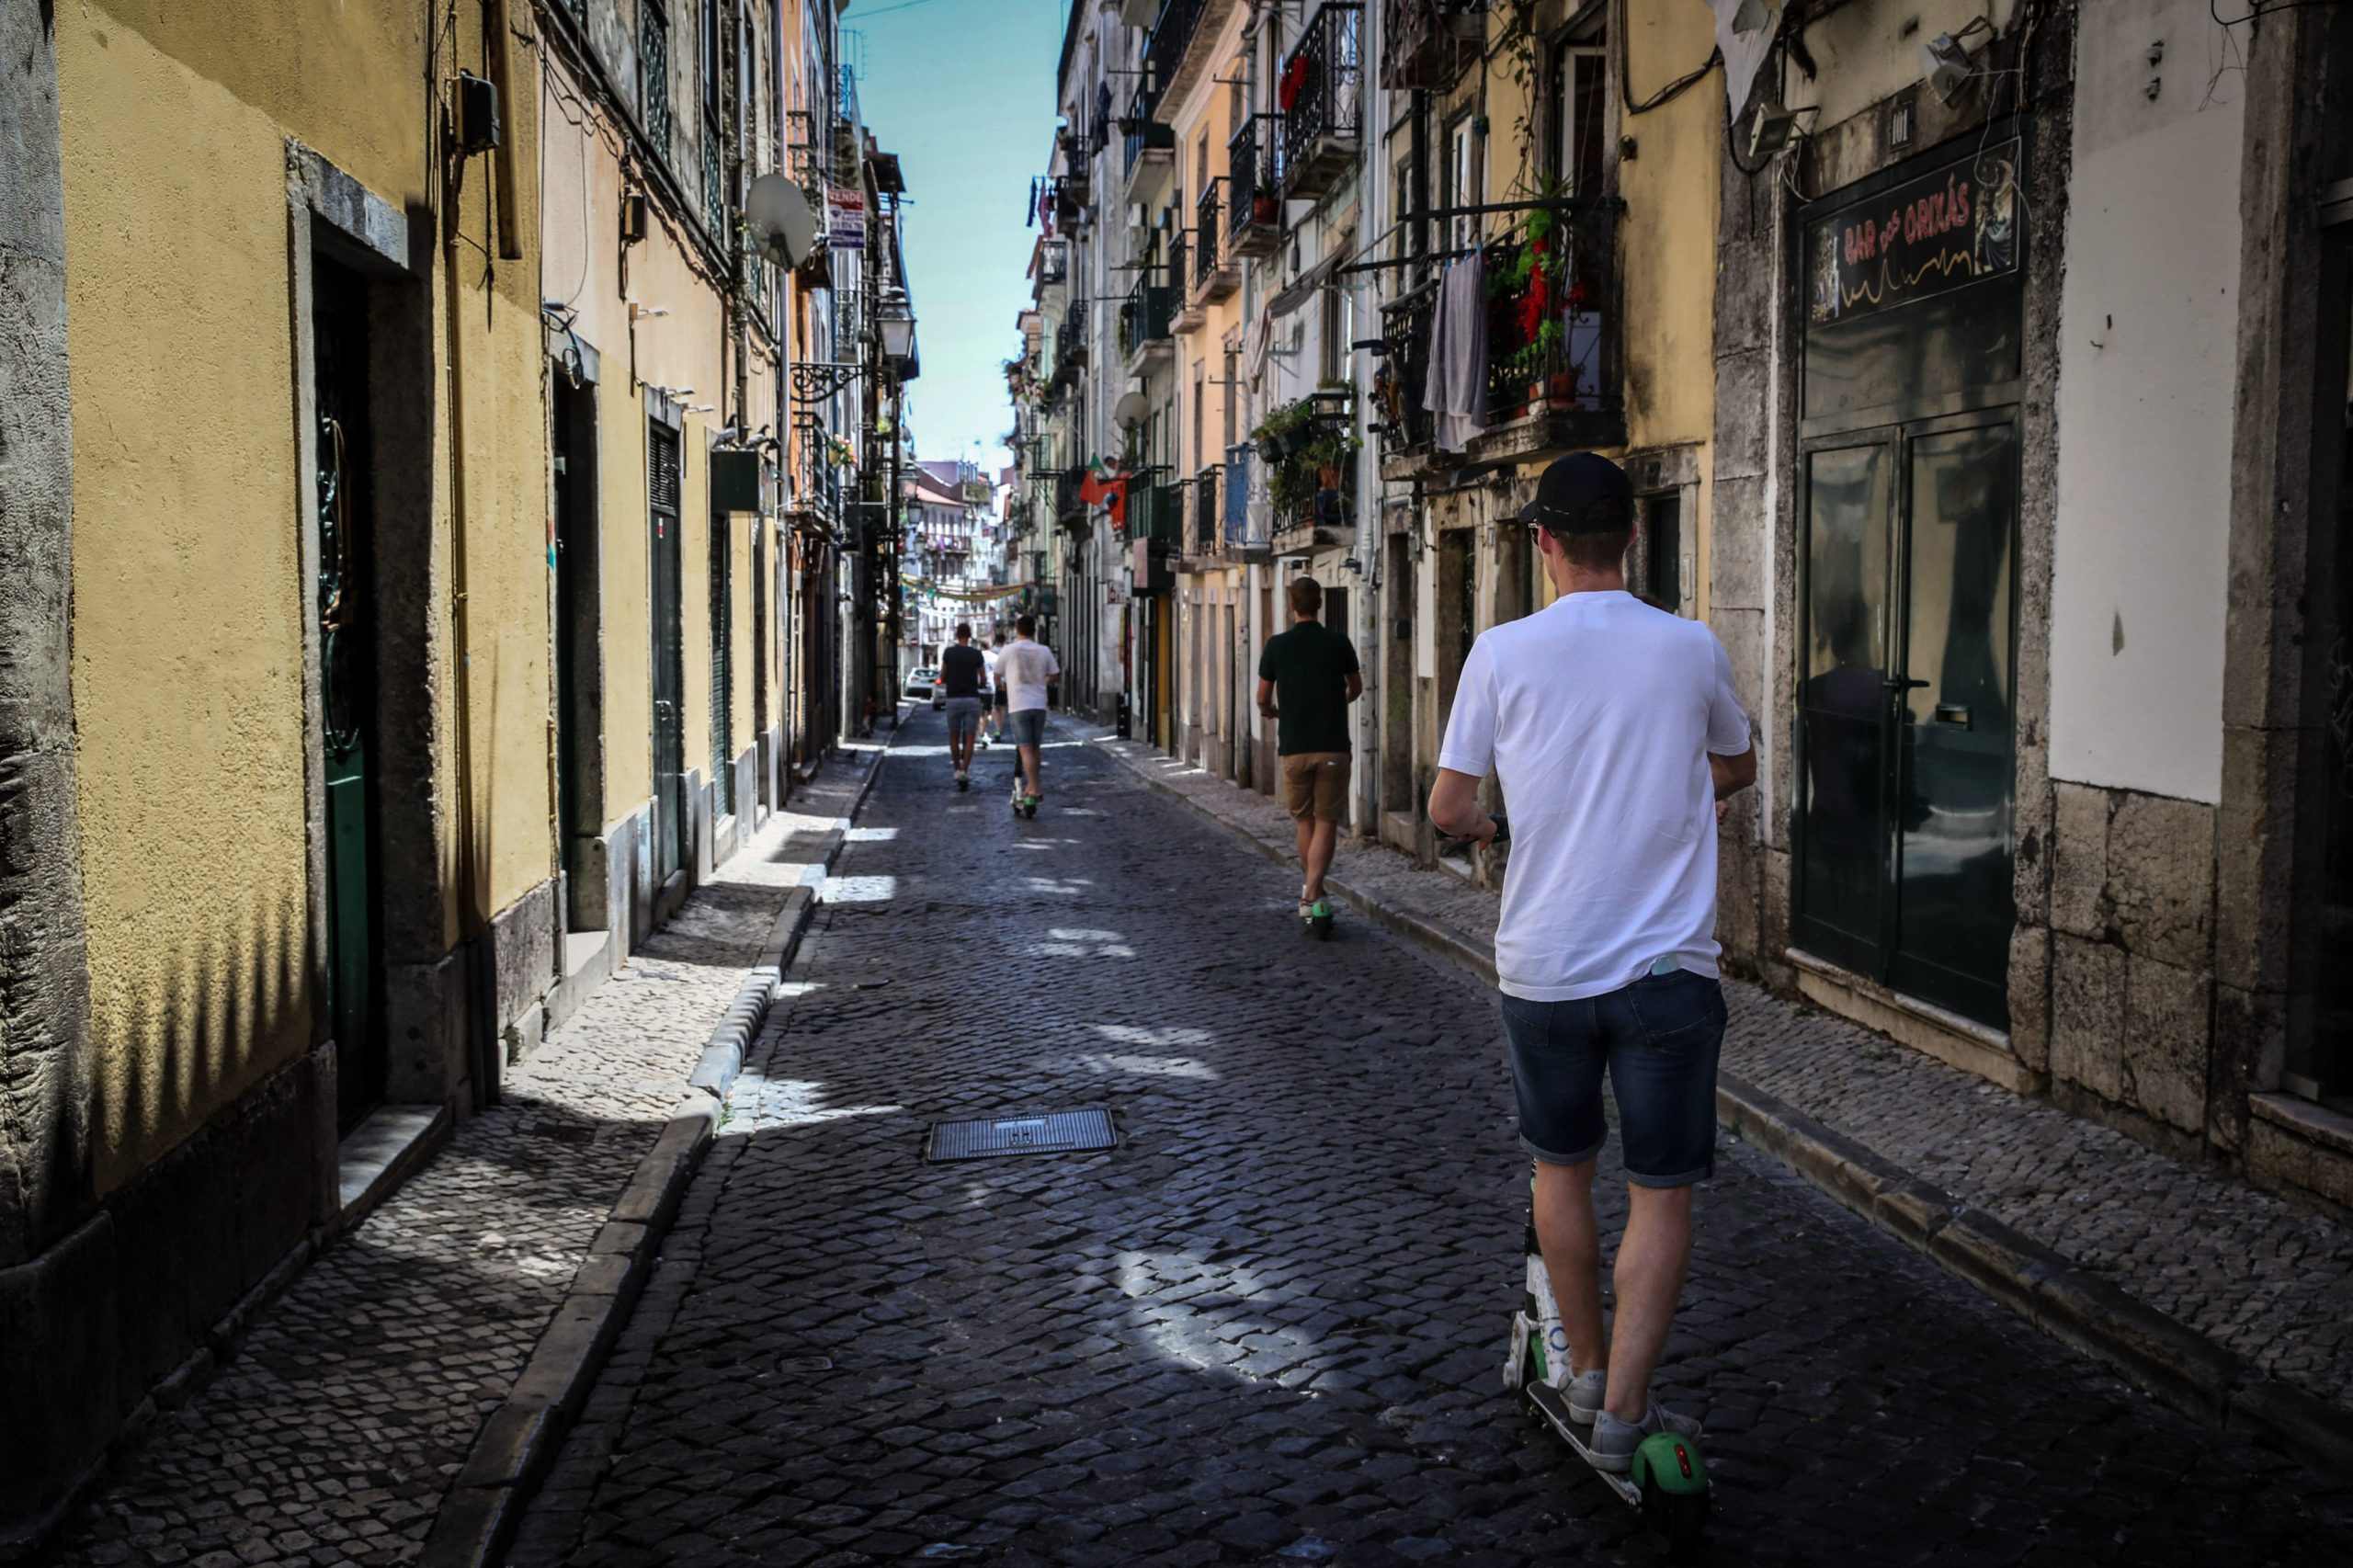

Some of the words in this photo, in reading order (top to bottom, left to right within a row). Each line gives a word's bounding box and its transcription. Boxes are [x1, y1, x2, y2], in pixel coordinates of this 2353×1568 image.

[1893, 108, 1908, 145] 101
[829, 191, 863, 203] VENDE
[1845, 220, 1876, 266] BAR
[1904, 172, 1970, 245] ORIXÁS
